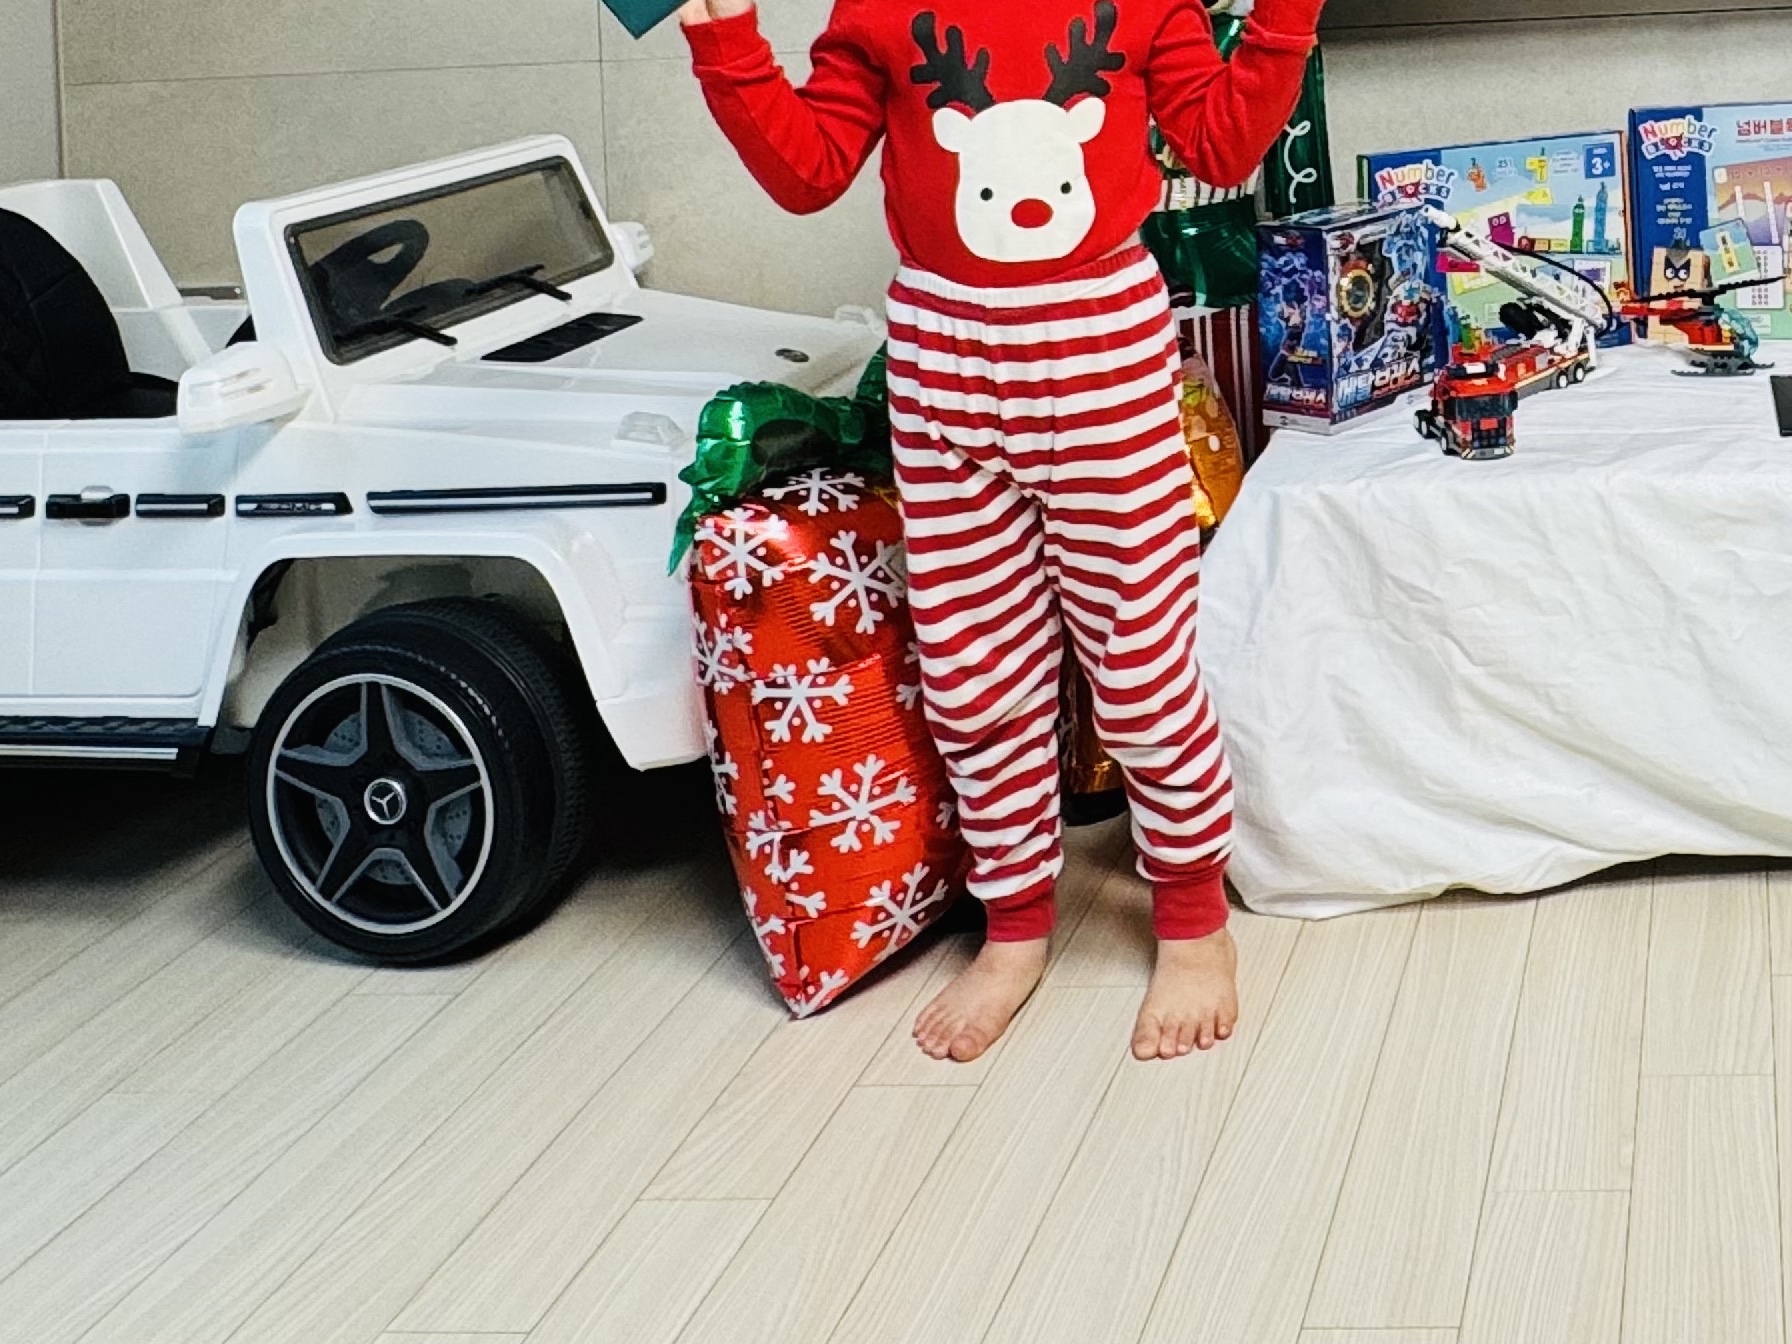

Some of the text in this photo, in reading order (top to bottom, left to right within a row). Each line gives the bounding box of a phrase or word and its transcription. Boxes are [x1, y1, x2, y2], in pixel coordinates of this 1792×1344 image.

[1642, 117, 1717, 142] Number
[1378, 162, 1455, 190] Number
[1591, 156, 1611, 175] 3+
